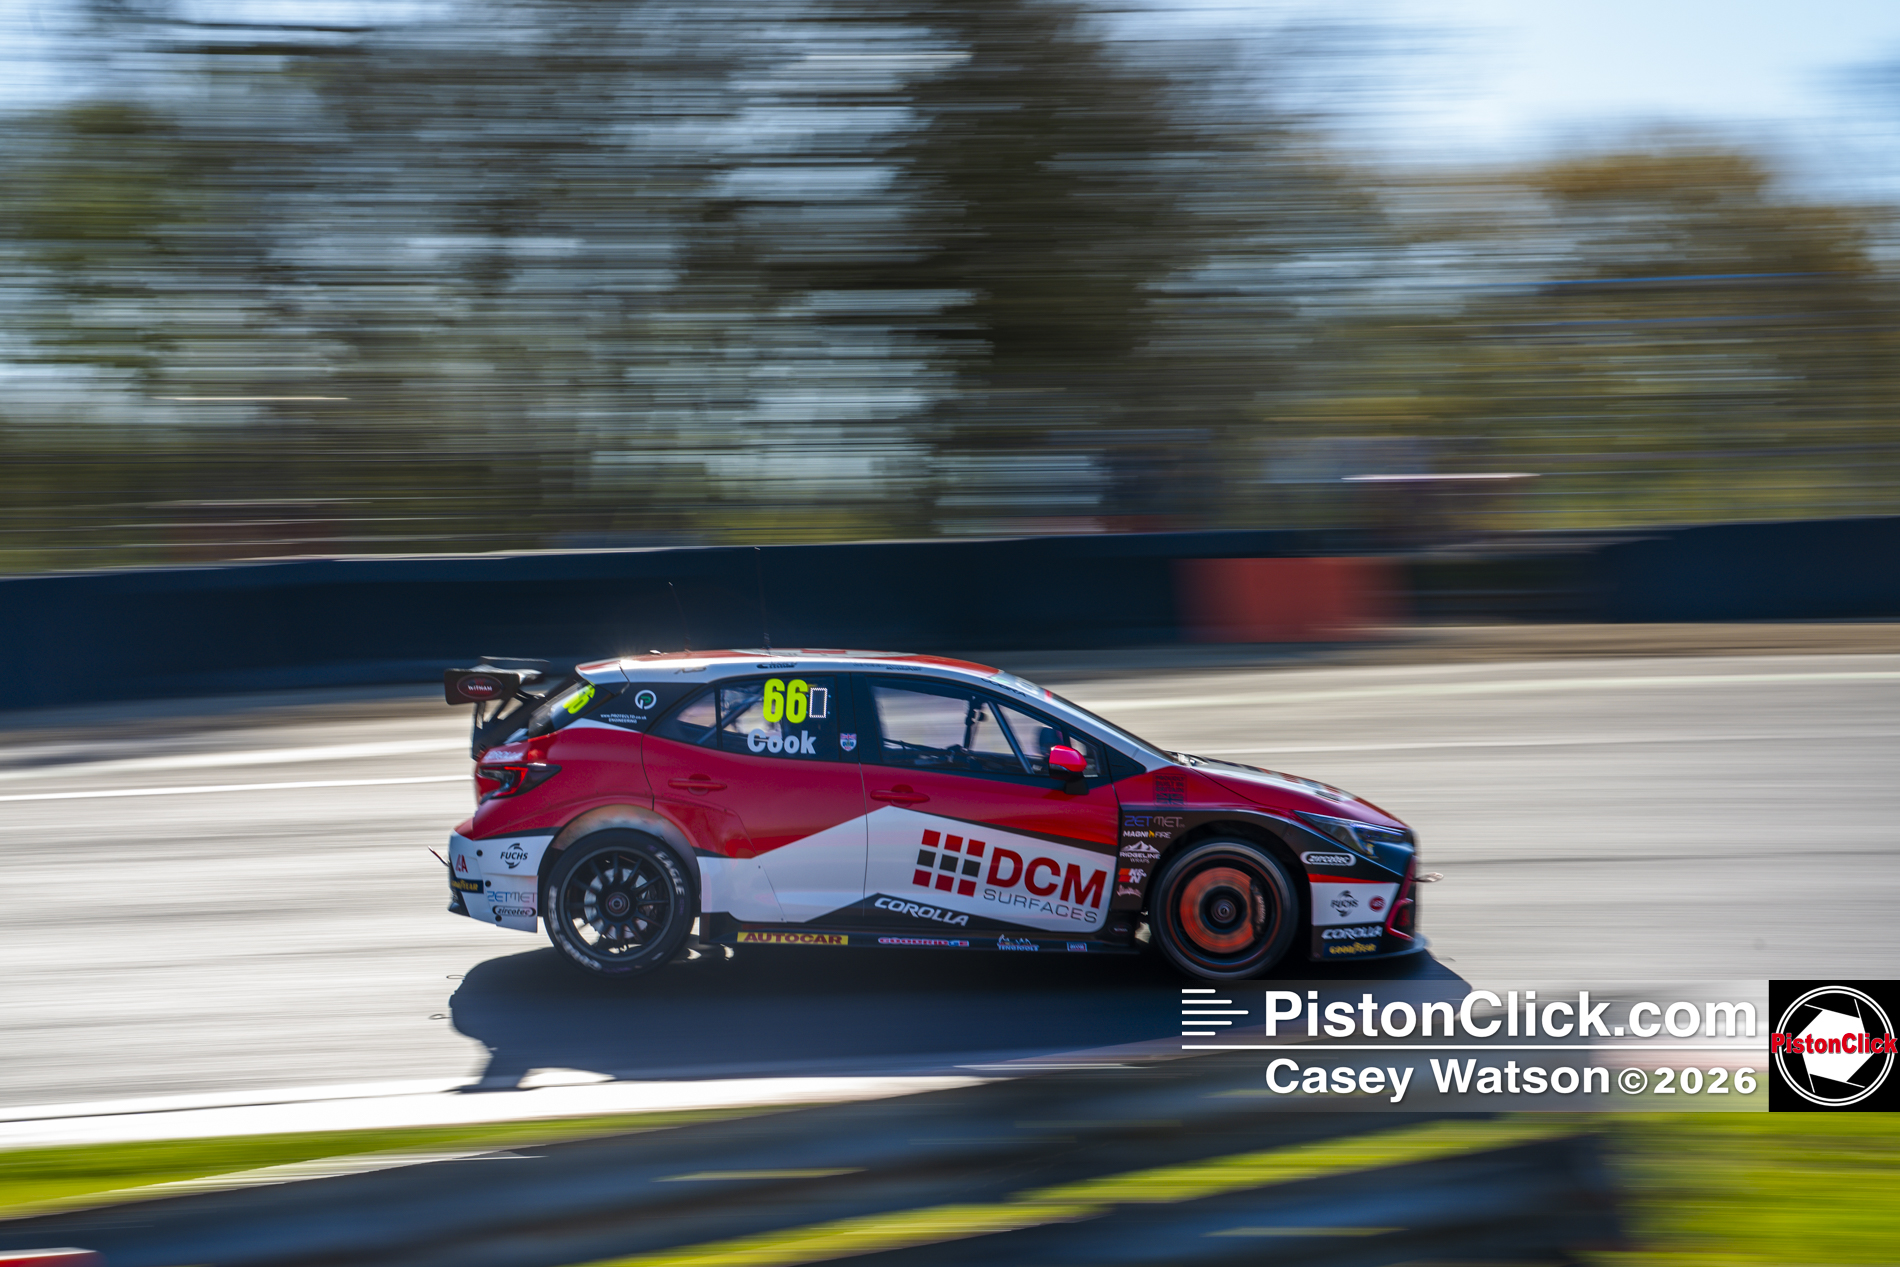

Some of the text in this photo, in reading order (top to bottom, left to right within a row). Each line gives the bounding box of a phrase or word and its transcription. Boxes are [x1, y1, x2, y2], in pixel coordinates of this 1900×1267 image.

[763, 678, 809, 724] 66
[747, 728, 817, 755] Cook
[500, 852, 529, 860] FUCHS
[1119, 851, 1161, 860] RIDGELINE
[654, 851, 686, 896] EAGLE
[986, 846, 1108, 909] DCM
[498, 906, 532, 917] zircotec
[874, 897, 969, 927] COROLLA
[983, 888, 1098, 924] SURFACES
[743, 932, 843, 945] AUTOCAR
[1321, 925, 1384, 940] COROLLA
